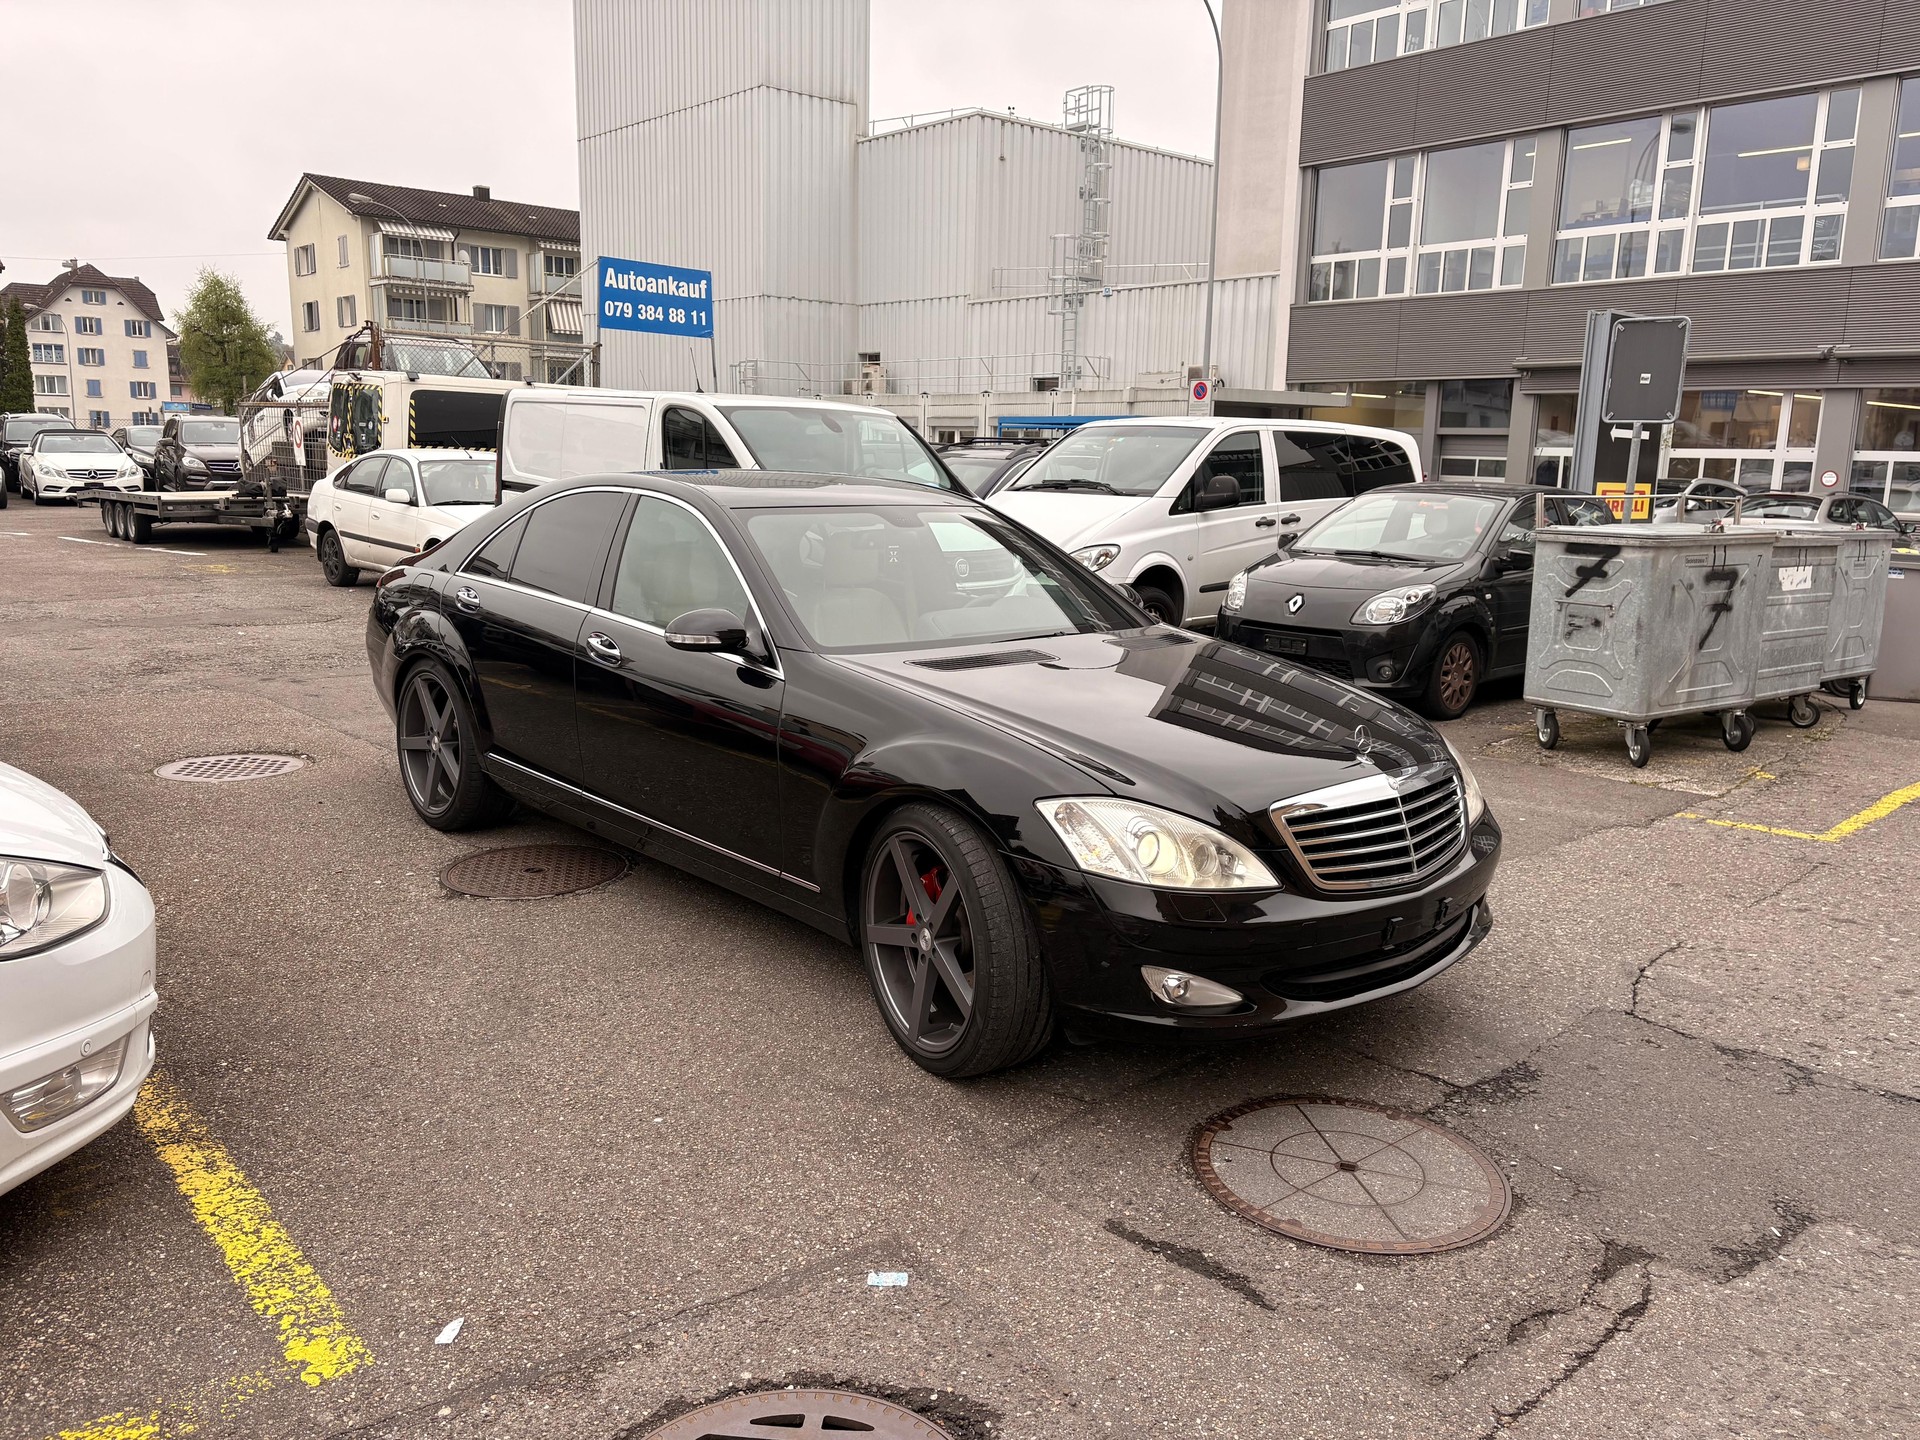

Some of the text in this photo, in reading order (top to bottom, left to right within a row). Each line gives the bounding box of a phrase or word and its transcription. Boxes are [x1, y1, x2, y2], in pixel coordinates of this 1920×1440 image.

[604, 267, 707, 299] Autoankauf
[604, 300, 706, 326] 079 384 88 11
[1757, 554, 1763, 567] 7
[1699, 568, 1739, 650] 7
